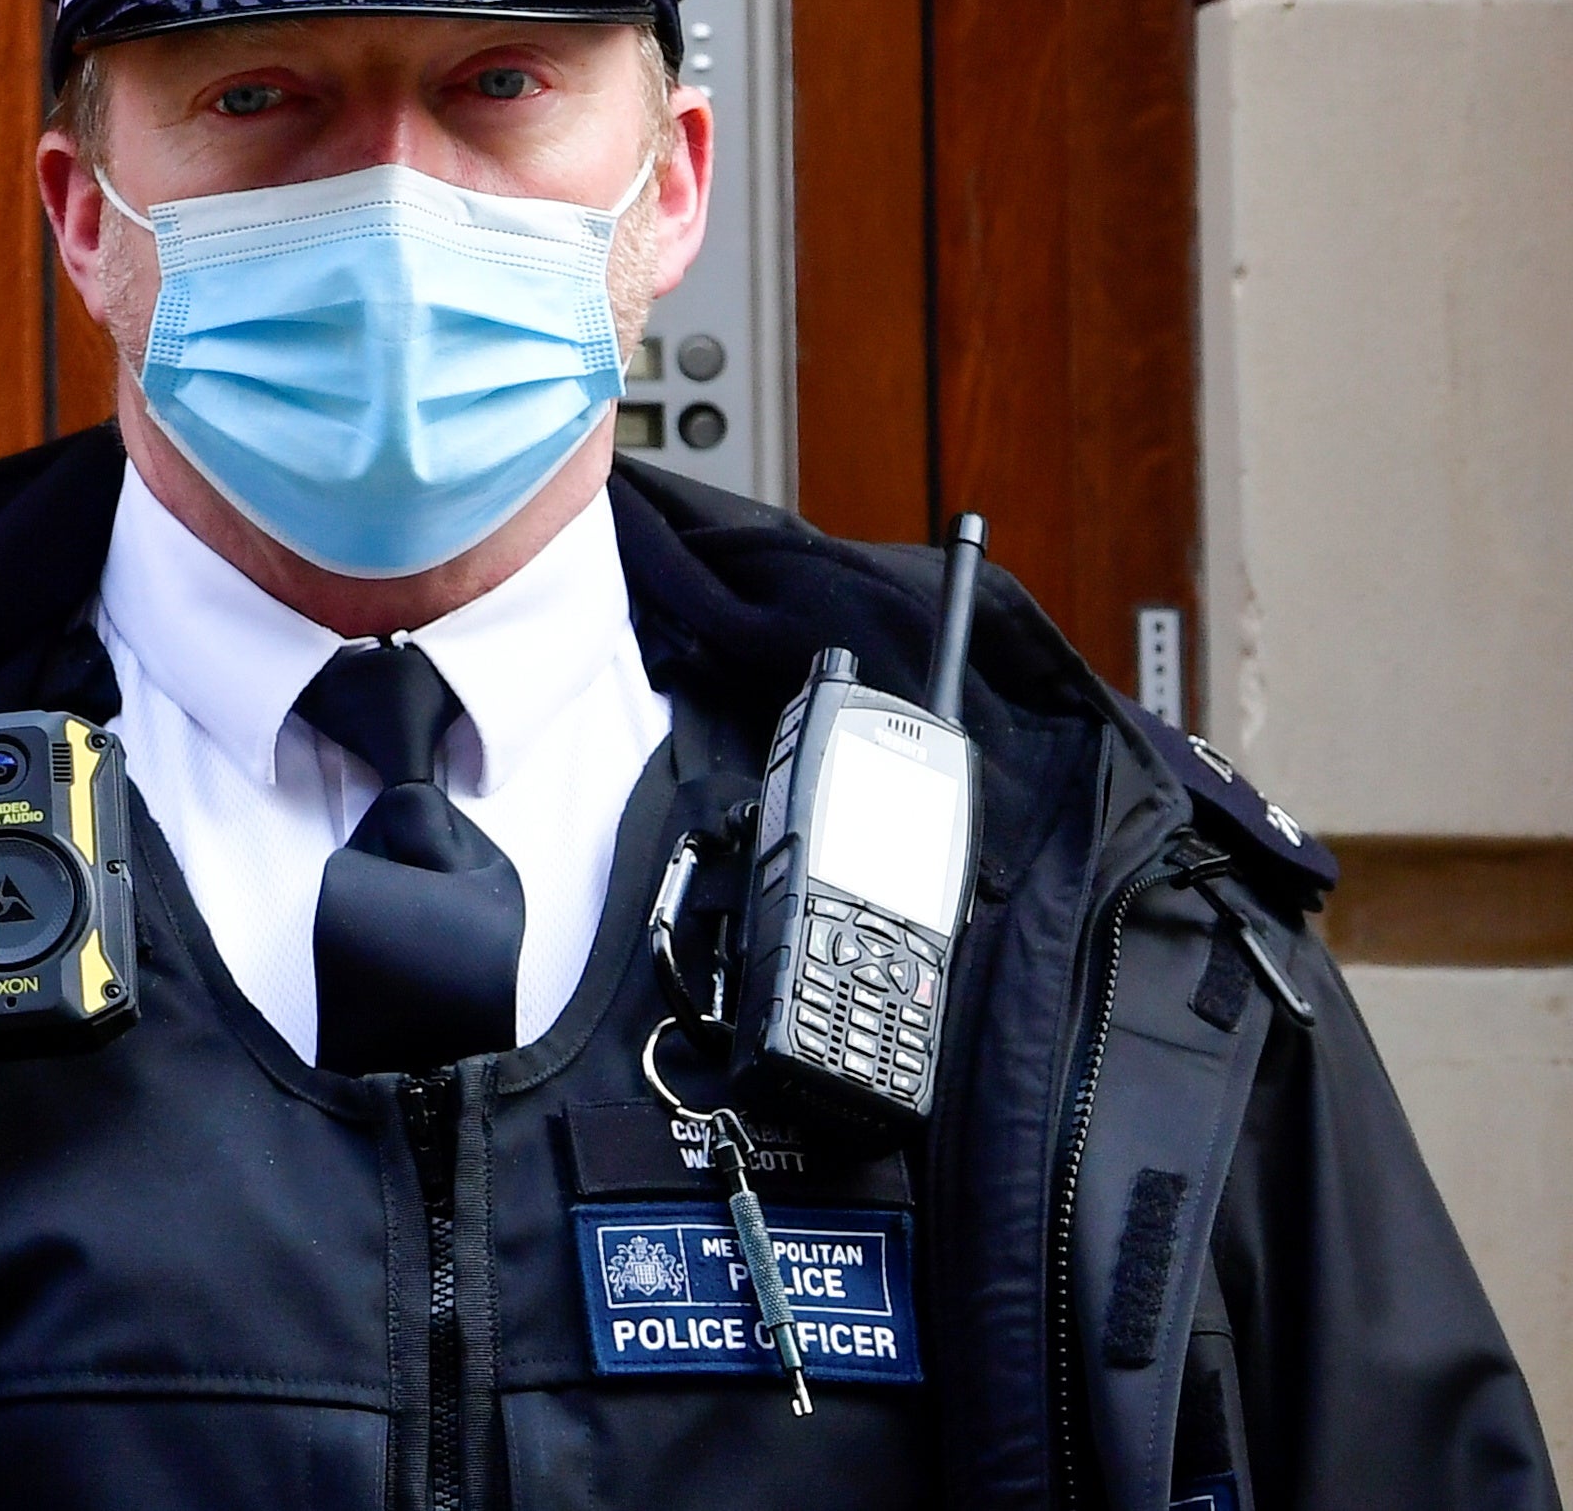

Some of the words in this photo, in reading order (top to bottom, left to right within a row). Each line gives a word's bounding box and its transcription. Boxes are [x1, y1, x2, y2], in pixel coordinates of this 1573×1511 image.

[3, 810, 44, 824] AUDIO
[613, 1318, 746, 1352] POLICE
[755, 1321, 898, 1359] OFICER
